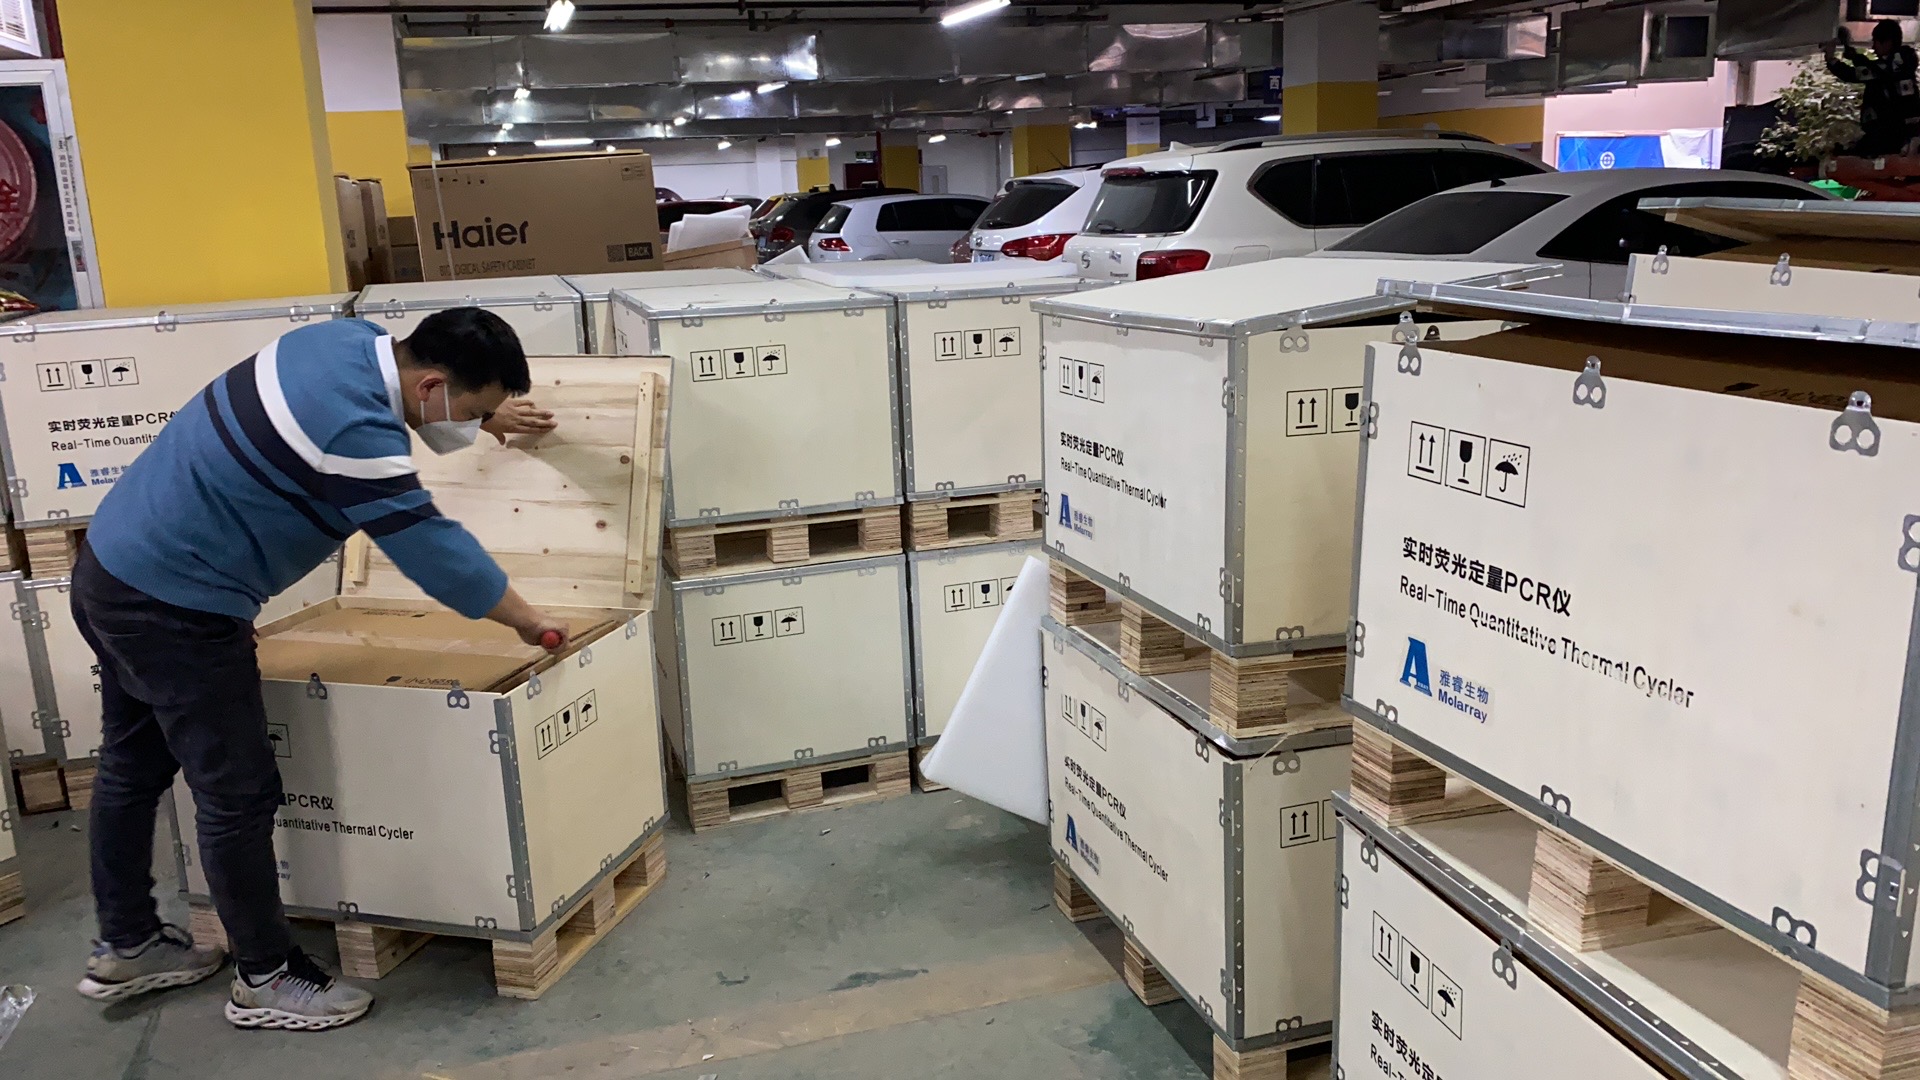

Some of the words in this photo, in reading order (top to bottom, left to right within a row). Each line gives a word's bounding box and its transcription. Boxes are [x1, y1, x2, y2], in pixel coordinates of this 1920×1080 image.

[433, 217, 528, 250] Haier
[627, 246, 650, 258] BACK
[51, 437, 111, 452] Real-Time
[1060, 431, 1125, 466] 实时荧光定量PCR仪
[1061, 456, 1087, 479] Real-Time
[1087, 467, 1121, 492] Quantitative
[1121, 479, 1146, 501] Thermal
[1402, 536, 1572, 617] 实时荧光定量PCR仪
[1400, 574, 1467, 619] Real-Time
[1469, 603, 1557, 656] Quantitative
[1561, 636, 1630, 685] Thermal
[1633, 666, 1695, 708] Cycler
[1439, 669, 1490, 706] 雅睿生物
[1438, 688, 1488, 724] Molarray
[274, 817, 331, 833] uantitative
[332, 820, 377, 837] Thermal
[378, 825, 414, 841] Cycler
[1124, 830, 1148, 864] Thermal
[1148, 854, 1169, 882] Cycler
